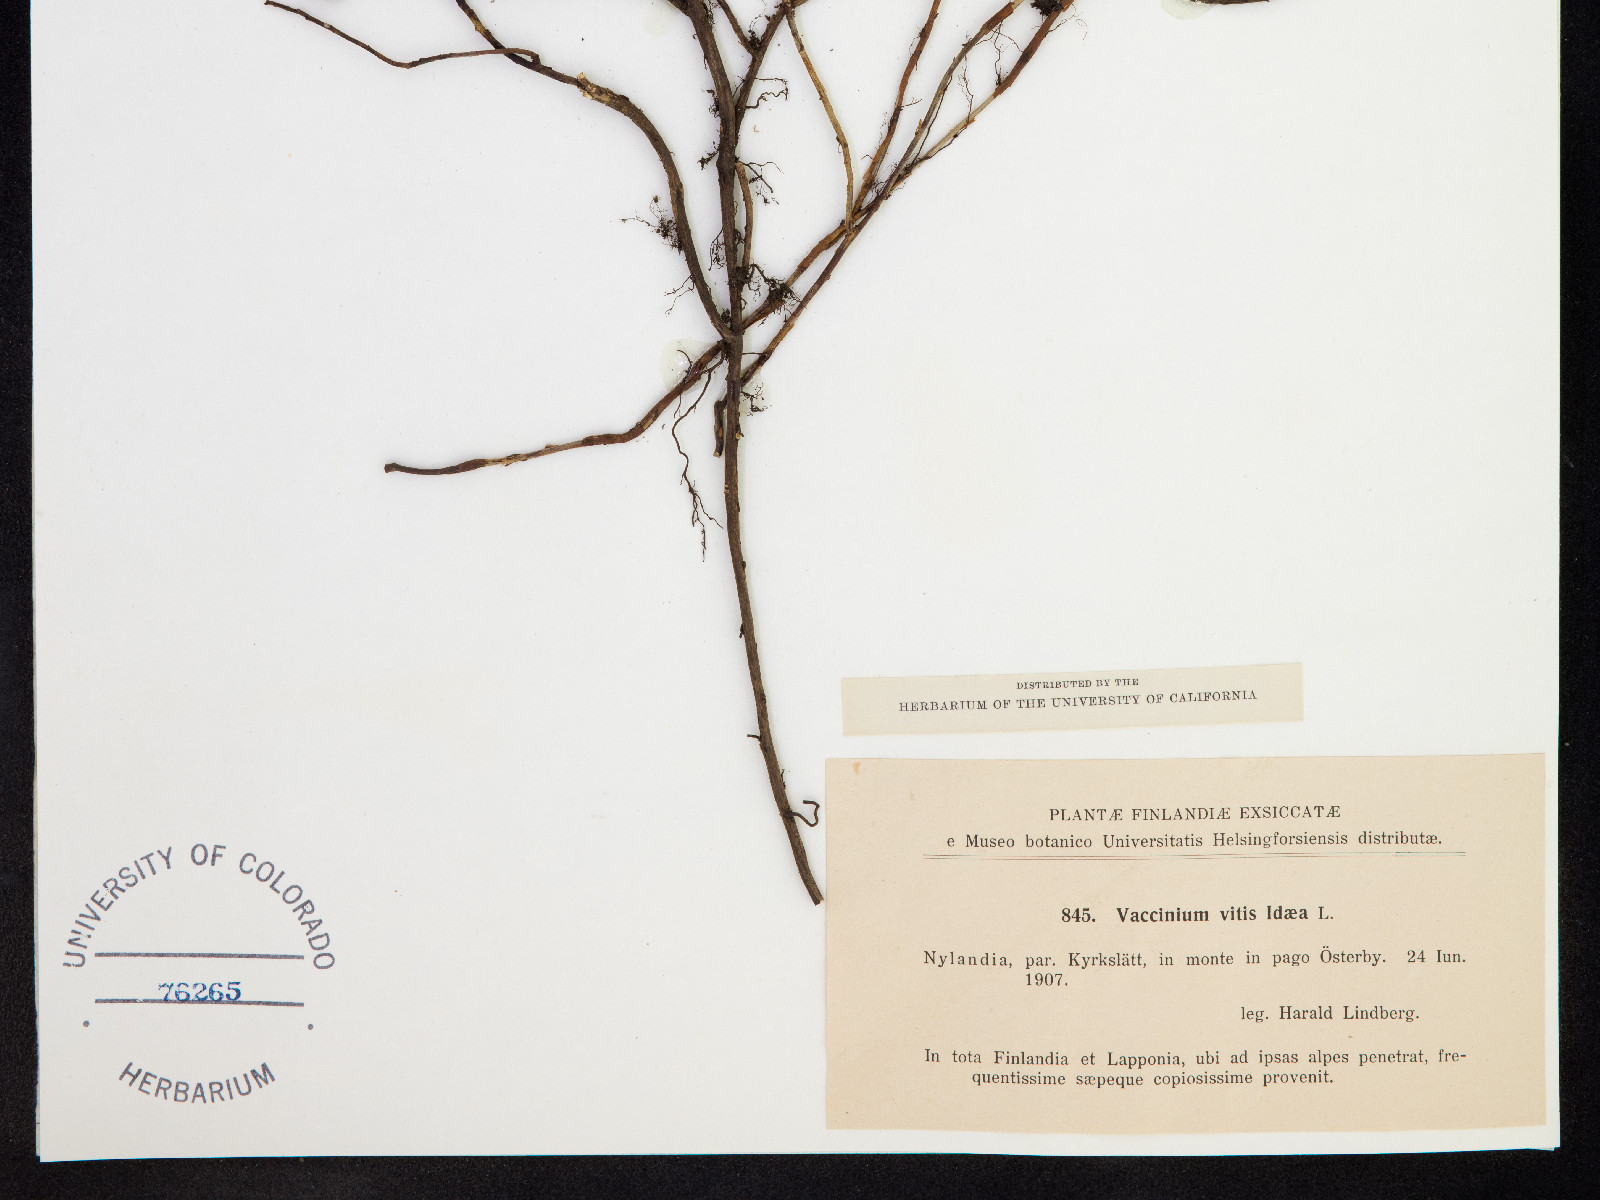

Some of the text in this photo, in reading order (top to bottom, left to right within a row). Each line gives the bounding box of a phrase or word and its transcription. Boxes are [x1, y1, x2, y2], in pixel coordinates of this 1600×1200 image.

[1016, 678, 1139, 689] DISTRIBUTED BY THE
[899, 689, 1257, 712] HERBARIUM OF THE UNIVERSITY OF CALIFORNIA
[1050, 806, 1340, 821] PLANTÆ FINLANDIÆ EXSICCATÆ
[947, 830, 1441, 849] e Museo botanico Universitatis Helsingforsiensis distributæ.
[62, 843, 335, 970] UNIVERSITY OF COLORADO
[1062, 905, 1333, 922] 845. Vaccinium vitis Idæa L.
[924, 946, 1465, 969] Nylandia, par. Kyrkslätt, in monte in pago Österby. 24 Iun.
[1026, 973, 1068, 987] 1907.
[158, 981, 242, 1001] 76265
[1241, 1005, 1419, 1022] leg. Harald Lindberg.
[925, 1048, 1466, 1069] In tota Finlandia et Lapponia, ubi ad ipsas alpes penetrat, fre-
[119, 1062, 275, 1104] HERBARIUM
[972, 1070, 1333, 1088] quentissime sæpeque copiosissime provenit.
